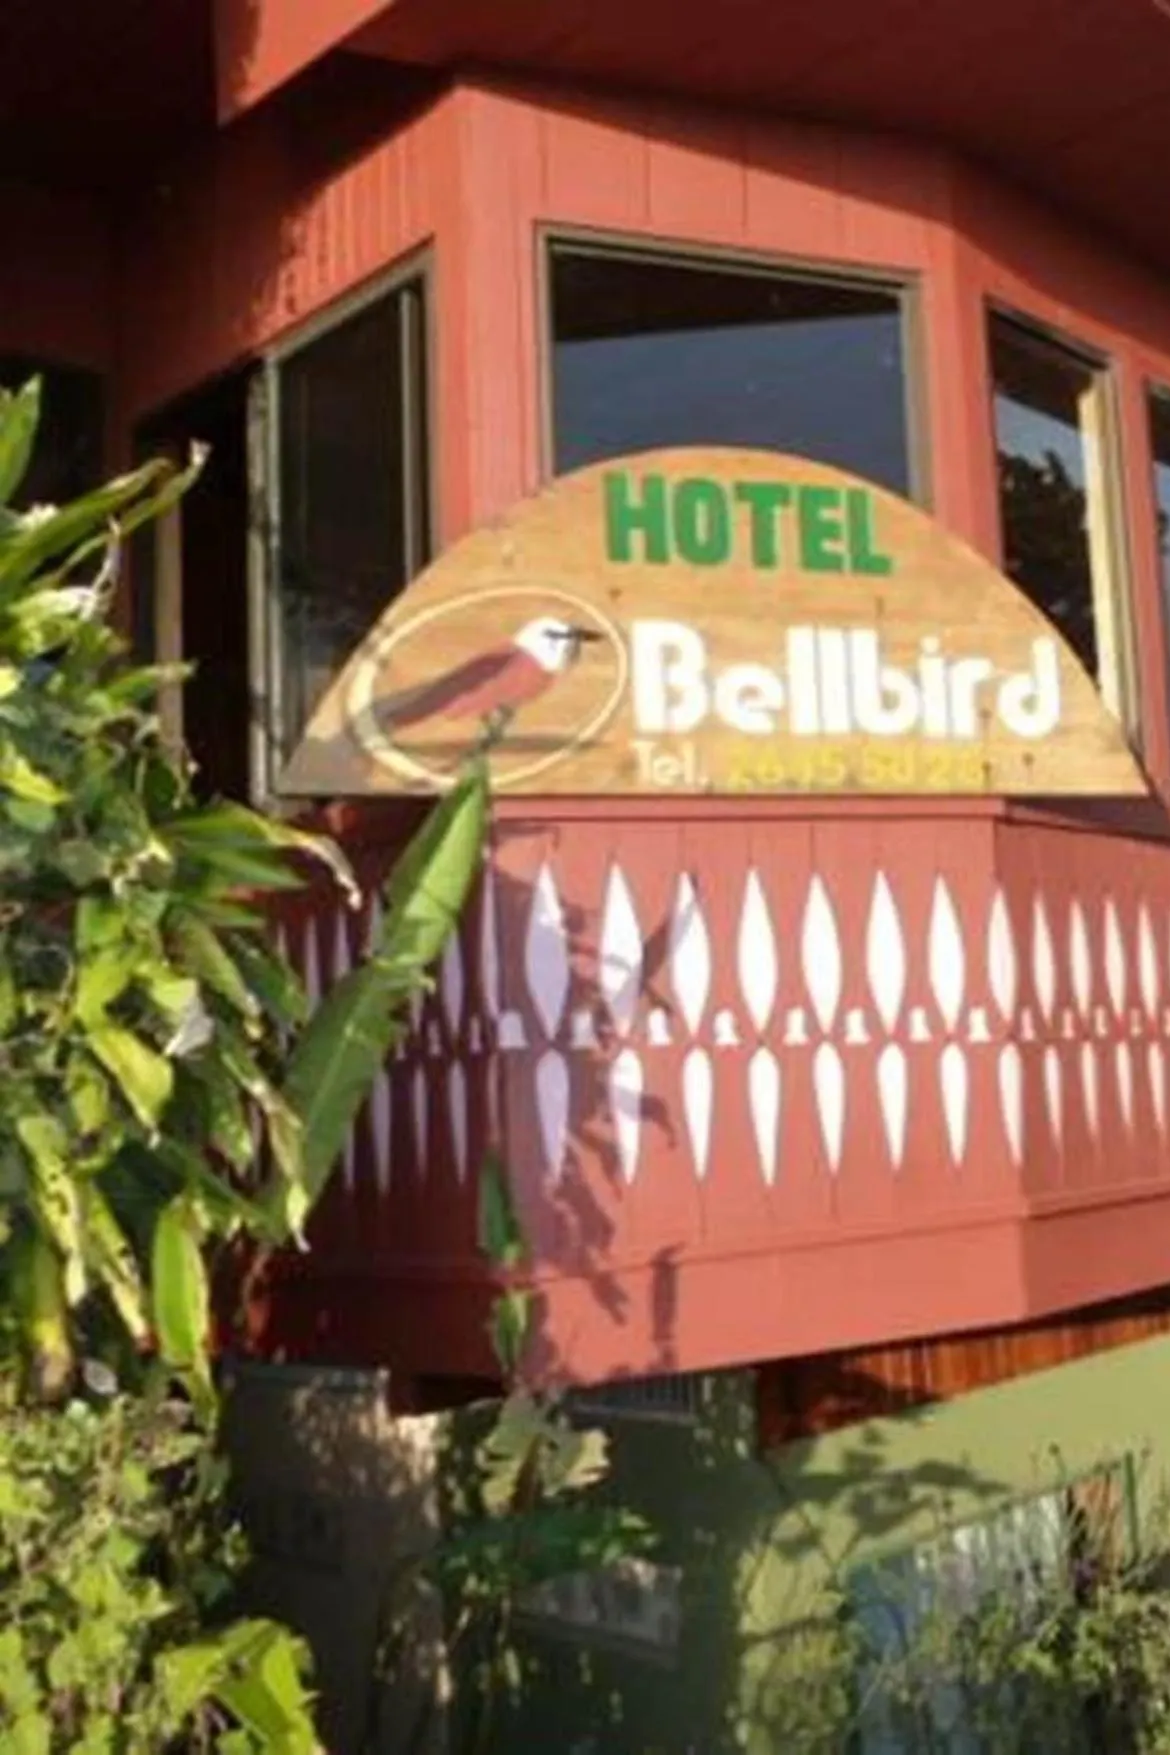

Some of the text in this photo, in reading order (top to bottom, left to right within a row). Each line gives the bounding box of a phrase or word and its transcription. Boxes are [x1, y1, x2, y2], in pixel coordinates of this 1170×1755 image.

[605, 470, 893, 576] HOTEL
[631, 619, 1060, 739] Bellbird
[630, 741, 709, 787] Tel.
